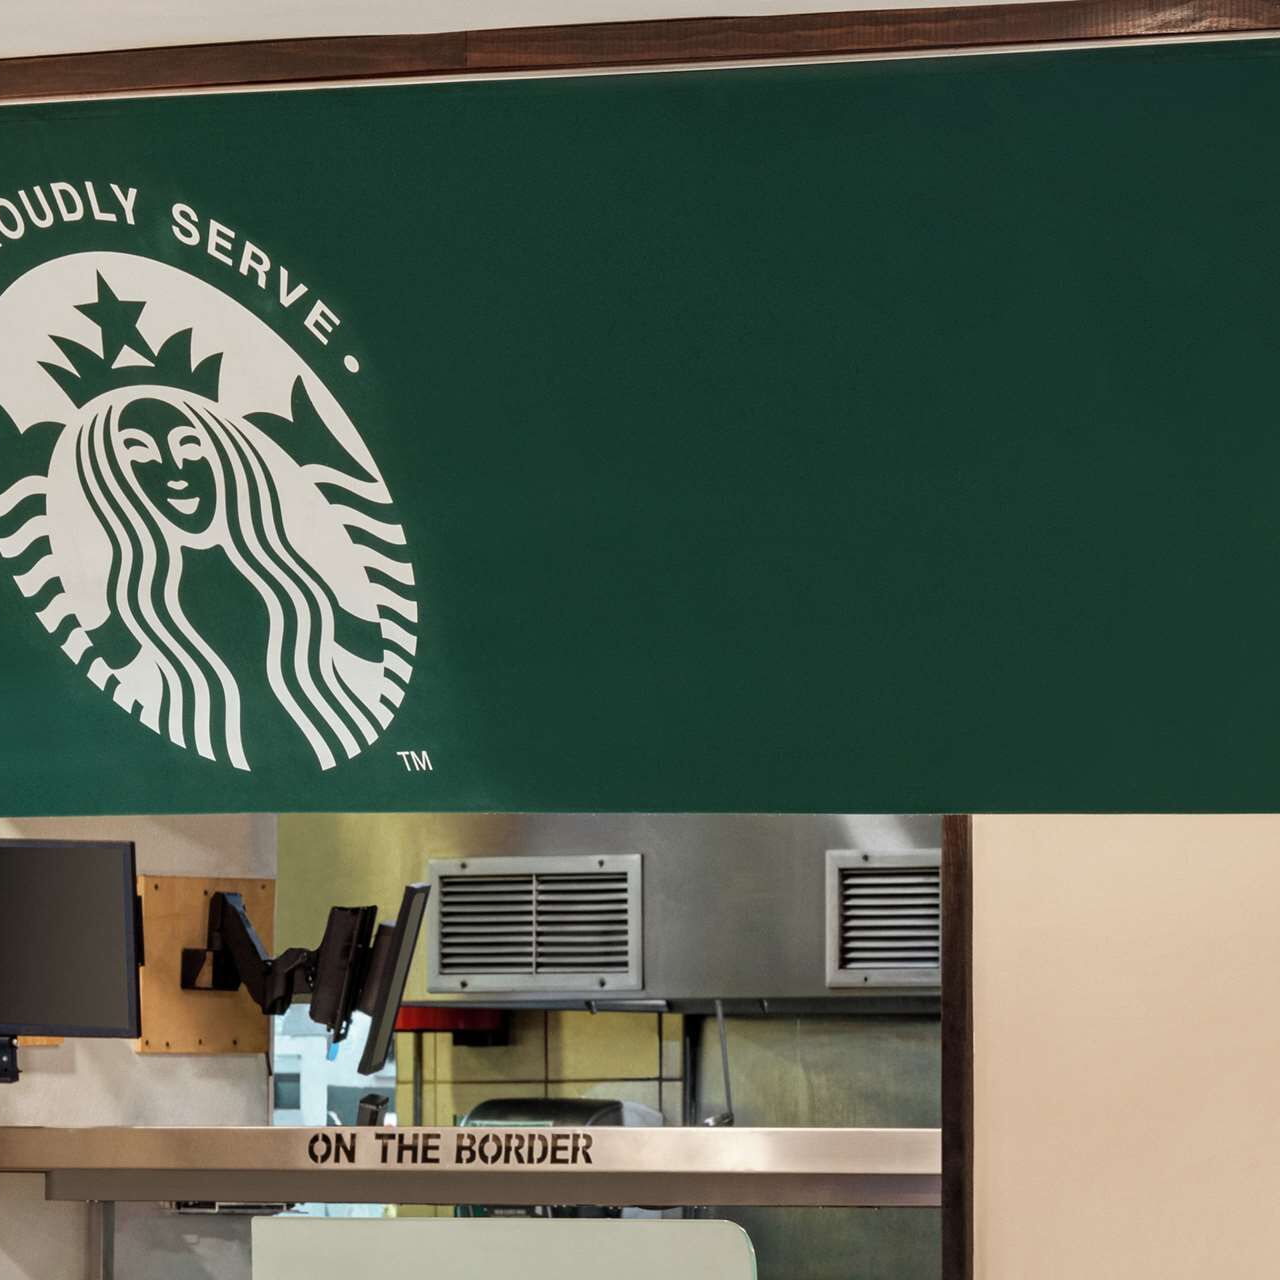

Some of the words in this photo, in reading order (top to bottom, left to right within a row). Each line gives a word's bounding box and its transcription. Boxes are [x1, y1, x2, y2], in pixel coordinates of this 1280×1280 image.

[170, 203, 341, 345] SERVE
[397, 750, 433, 771] TM
[308, 1133, 357, 1164] ON
[375, 1133, 441, 1164] THE
[455, 1133, 593, 1165] BORDER
